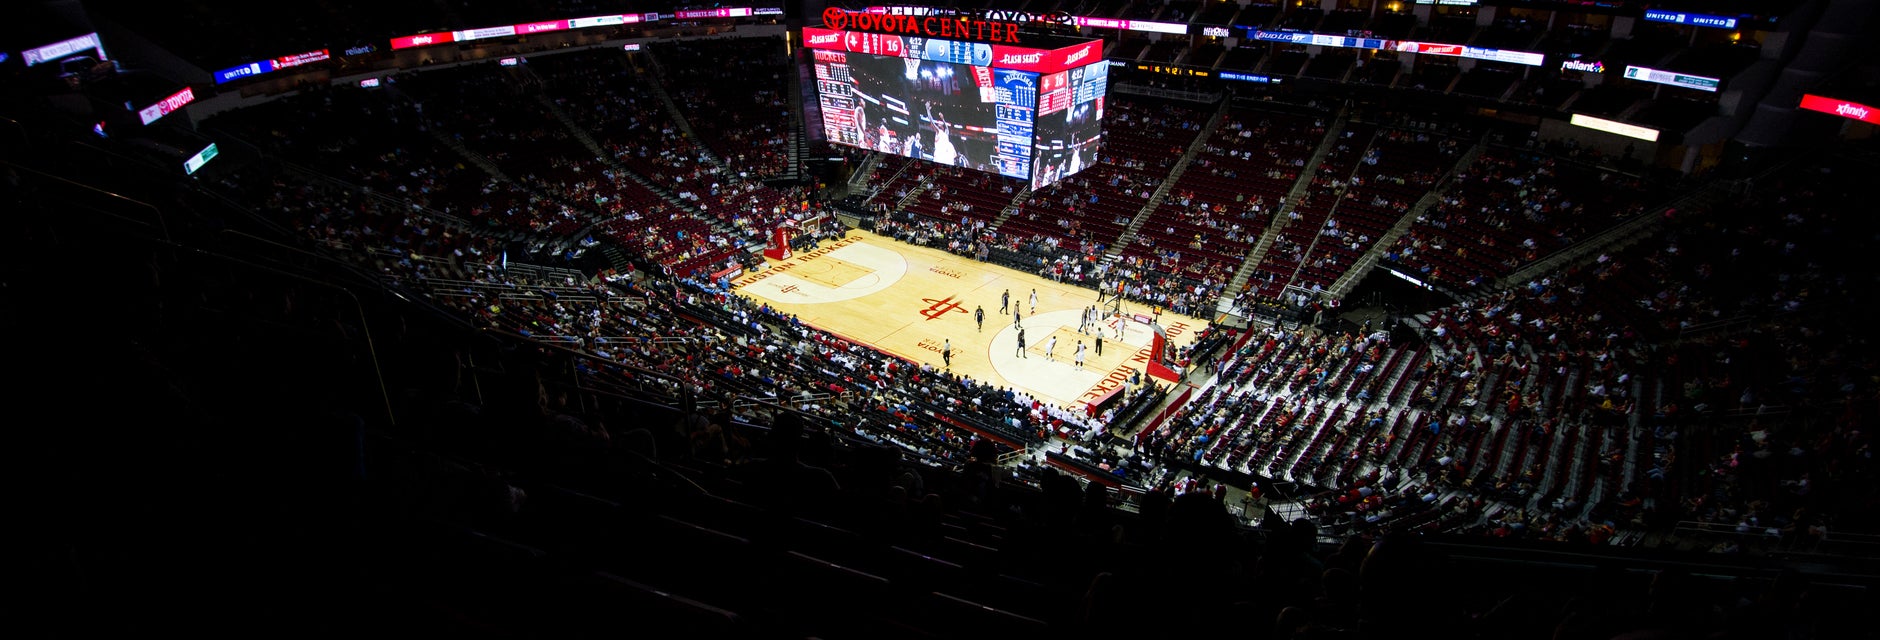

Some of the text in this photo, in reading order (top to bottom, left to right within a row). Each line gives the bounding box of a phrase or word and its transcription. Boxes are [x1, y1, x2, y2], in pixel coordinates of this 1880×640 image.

[1646, 12, 1676, 21] UNITED
[1693, 17, 1726, 26] UNITED
[848, 12, 1020, 43] TOYOTA CENTER
[345, 45, 369, 56] reliant
[886, 40, 898, 52] 16
[939, 45, 946, 57] 9
[814, 50, 847, 63] ROCKETS
[1001, 51, 1042, 64] FLASH SEATS
[1065, 53, 1078, 65] FLASH
[1562, 59, 1595, 72] reliant
[224, 67, 251, 80] UNITED
[1071, 68, 1083, 80] 4:12
[1054, 74, 1064, 87] 16
[167, 89, 195, 110] TOYOTA
[1836, 103, 1868, 119] xfinity
[796, 235, 864, 262] ROCKETS
[928, 267, 961, 279] TOYOTA
[917, 341, 956, 358] TYOTA
